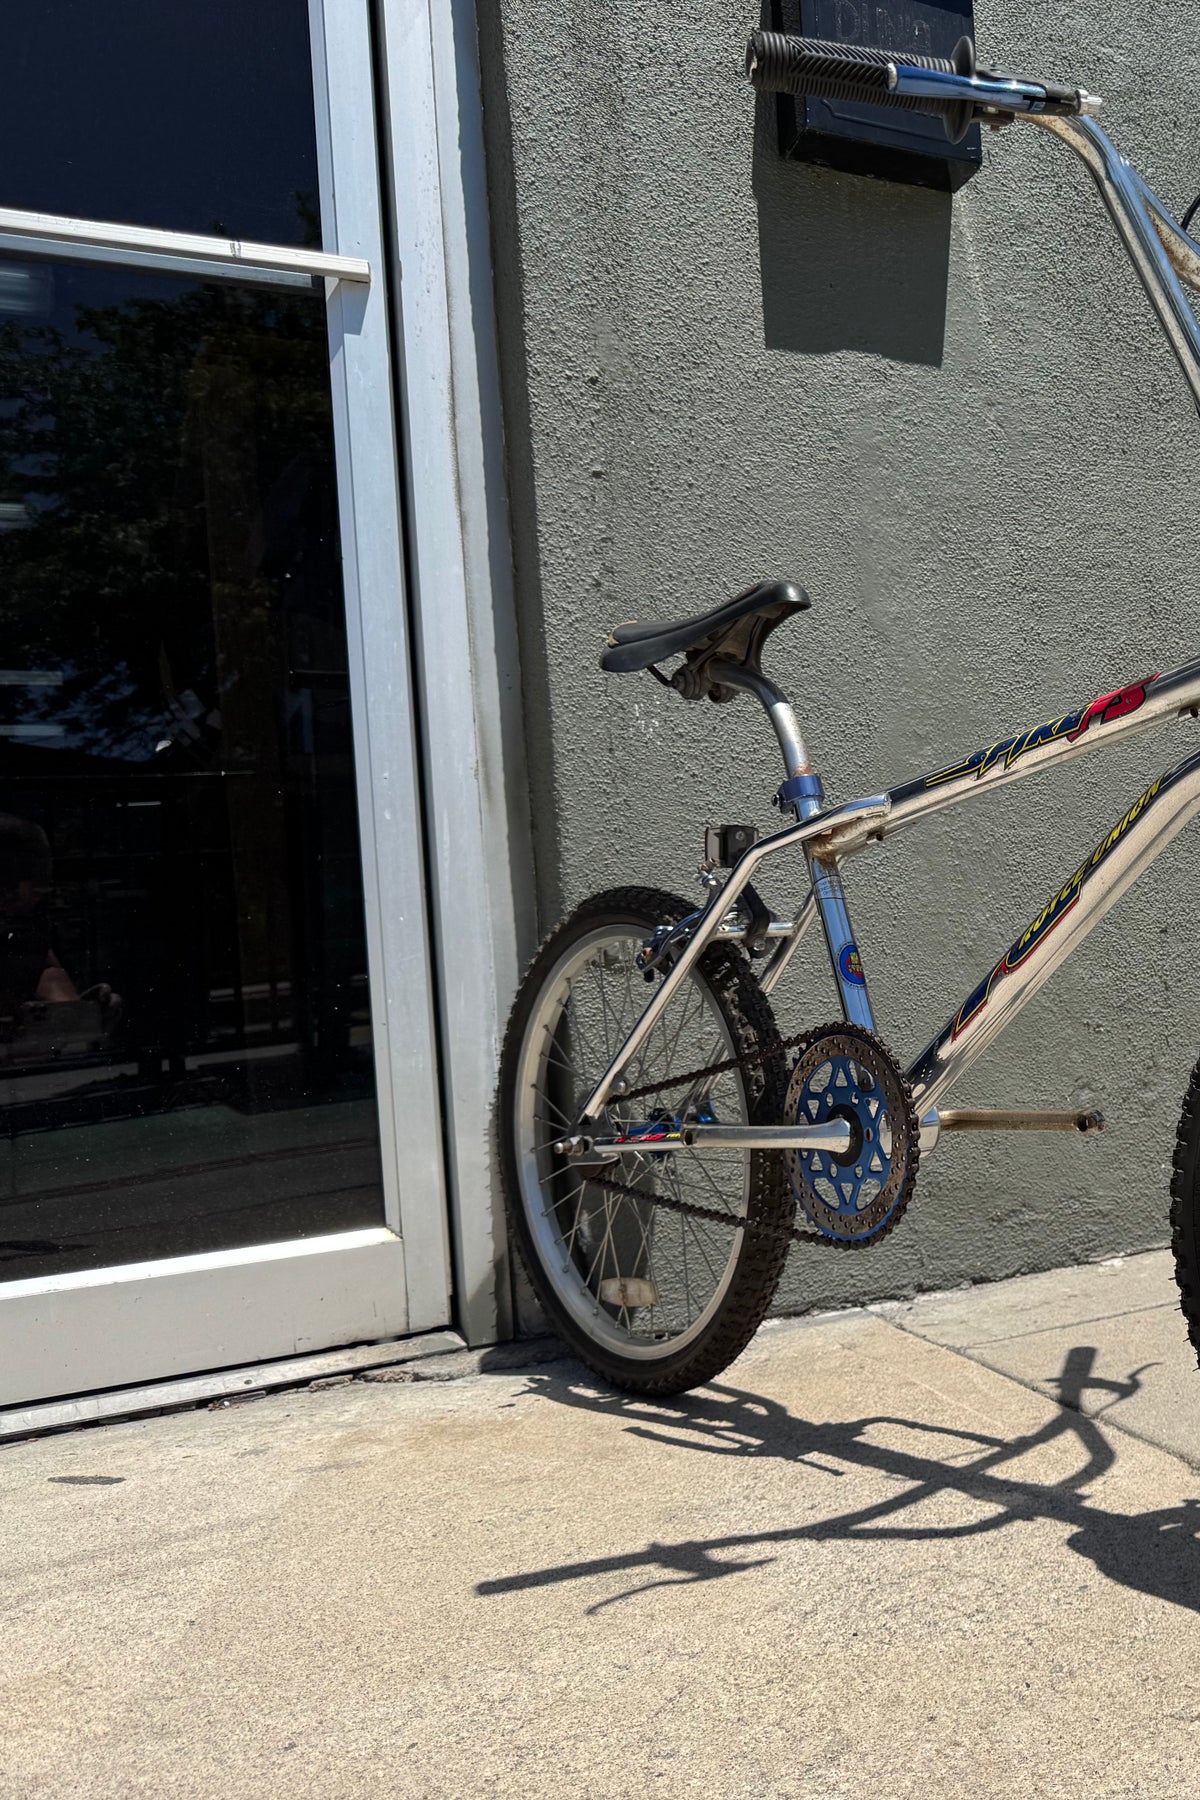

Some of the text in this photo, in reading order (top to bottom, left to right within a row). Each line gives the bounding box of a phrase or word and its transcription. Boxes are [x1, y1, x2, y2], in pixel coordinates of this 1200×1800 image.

[925, 702, 1095, 788] SPIKE
[1018, 776, 1165, 948] ROYCE UNION
